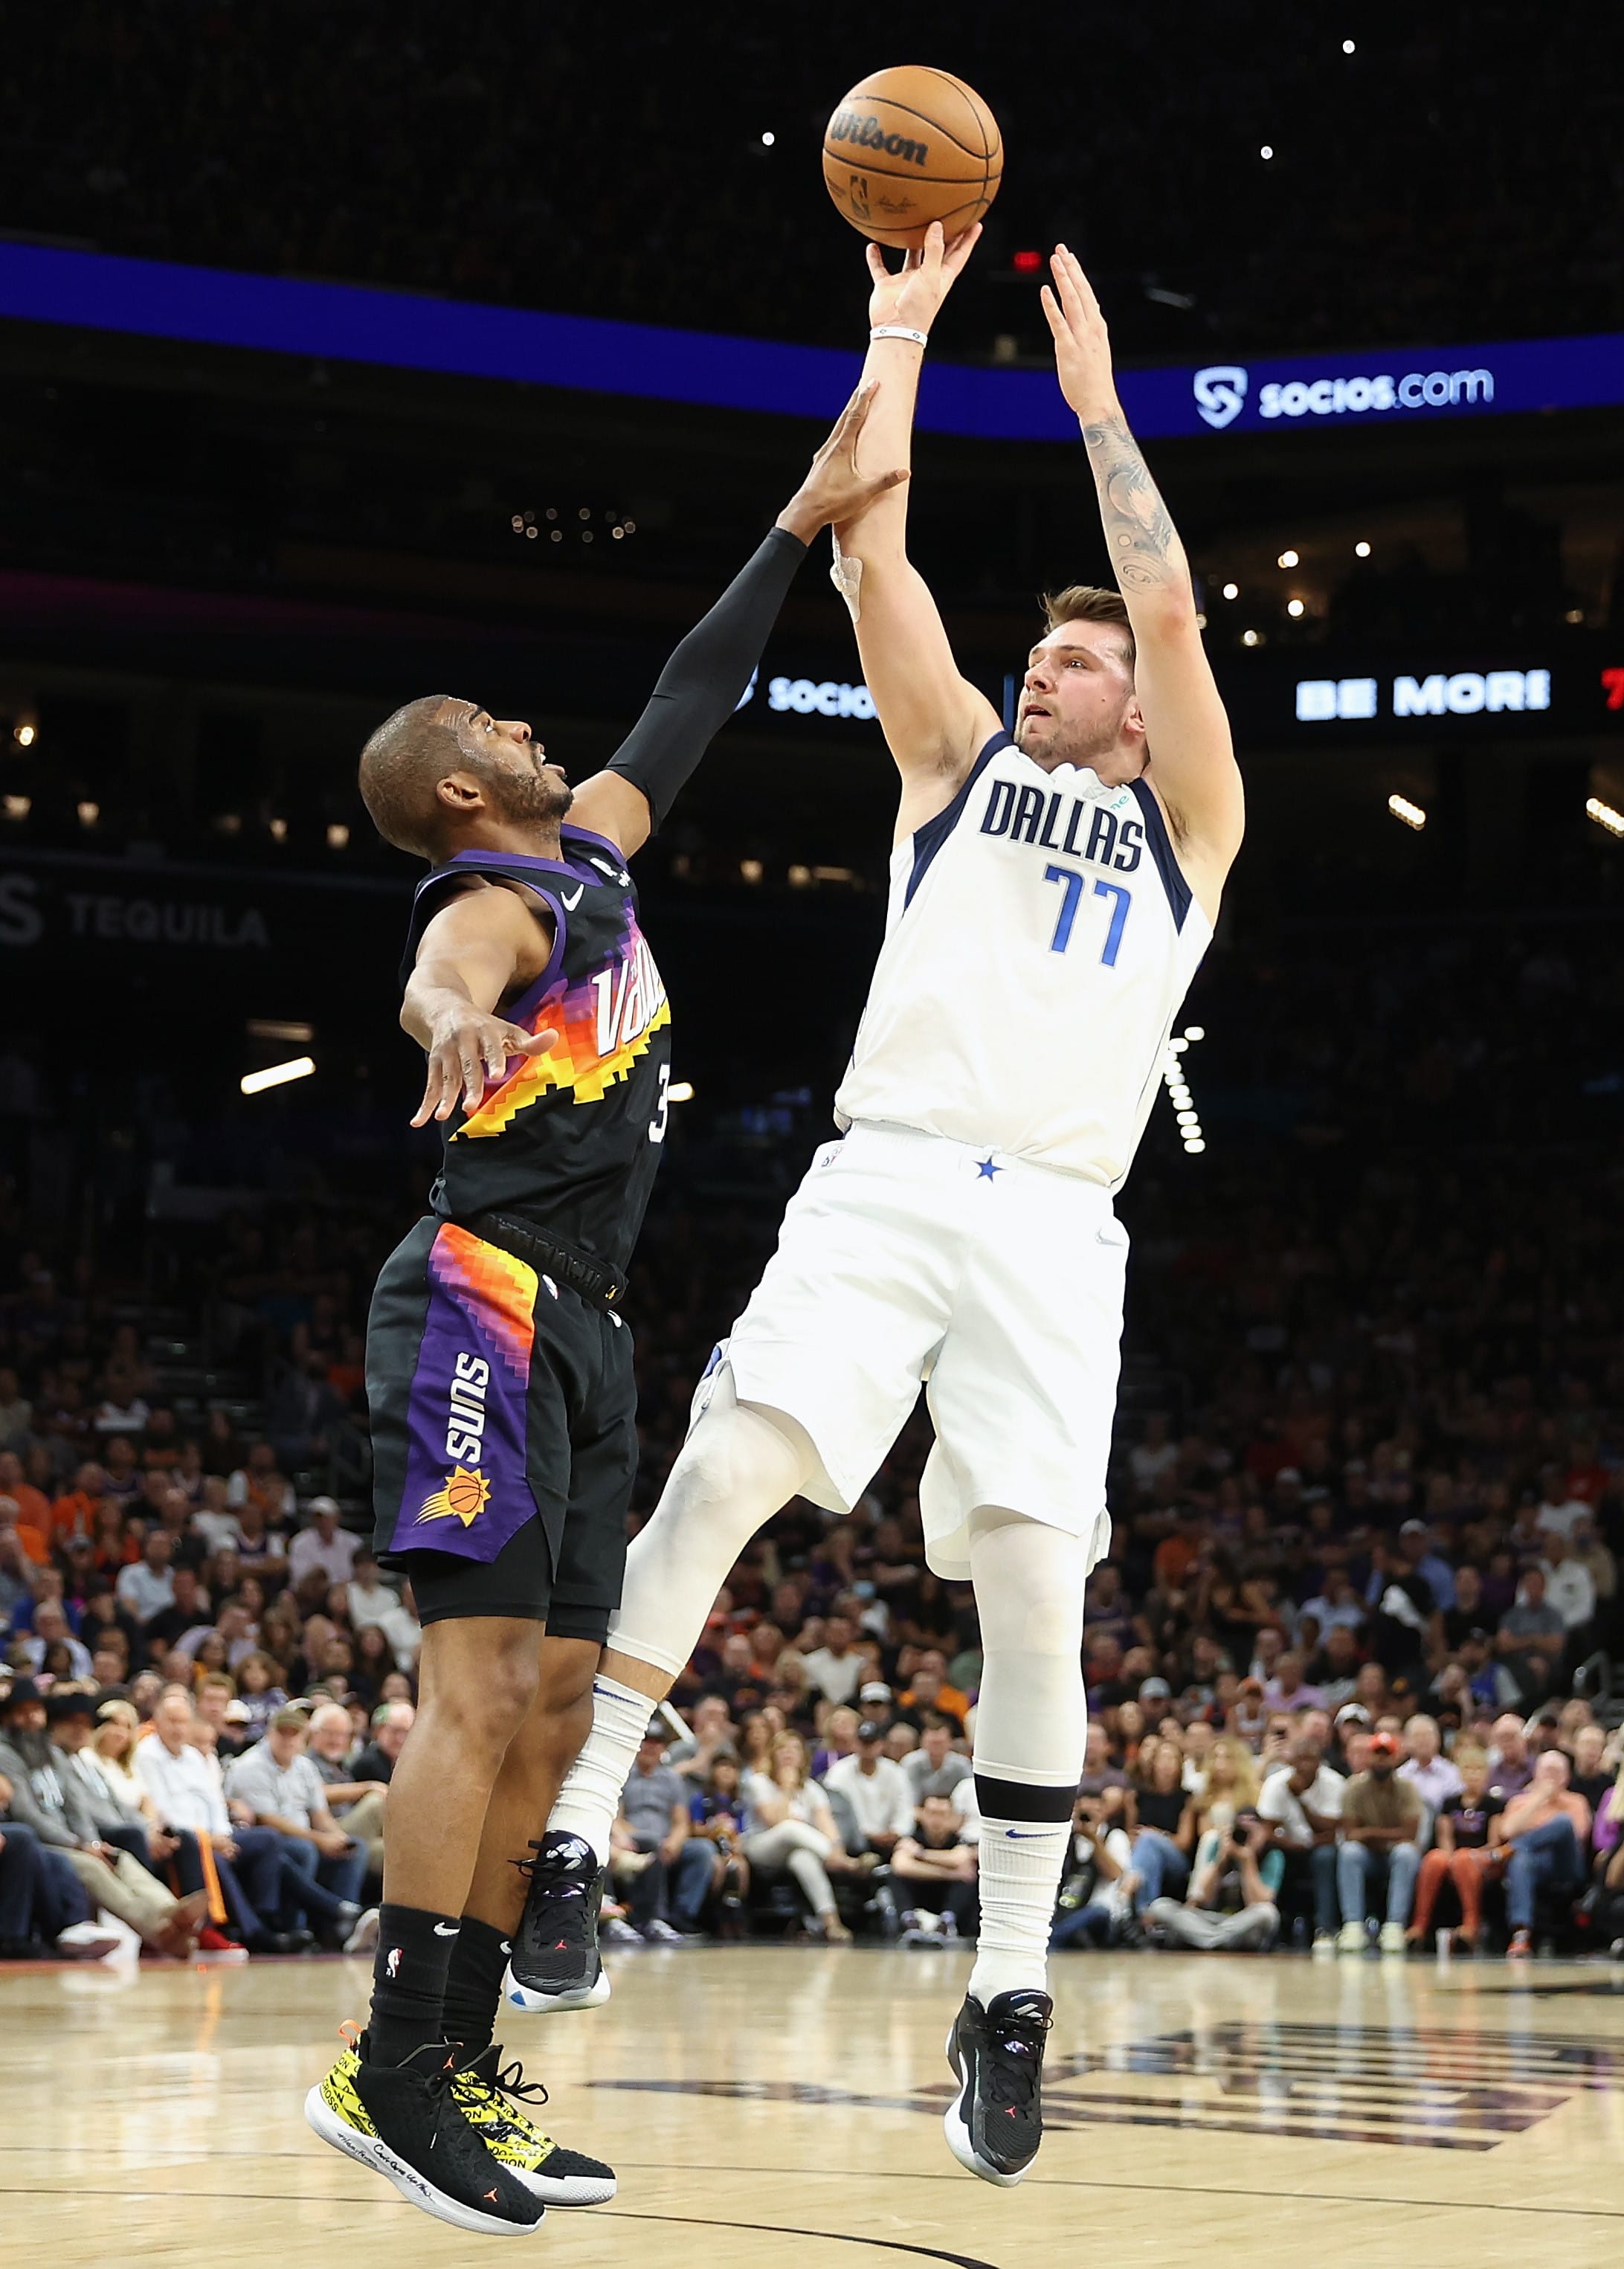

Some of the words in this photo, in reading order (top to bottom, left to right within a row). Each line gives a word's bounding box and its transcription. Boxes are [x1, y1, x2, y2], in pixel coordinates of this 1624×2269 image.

[831, 112, 929, 167] Wilson
[769, 677, 880, 719] SOCIO
[978, 779, 1143, 874] DALLAS
[65, 892, 271, 950] TEQUILA
[1043, 863, 1131, 969] 77
[648, 1062, 670, 1143] 3
[445, 1351, 490, 1464] SUNS
